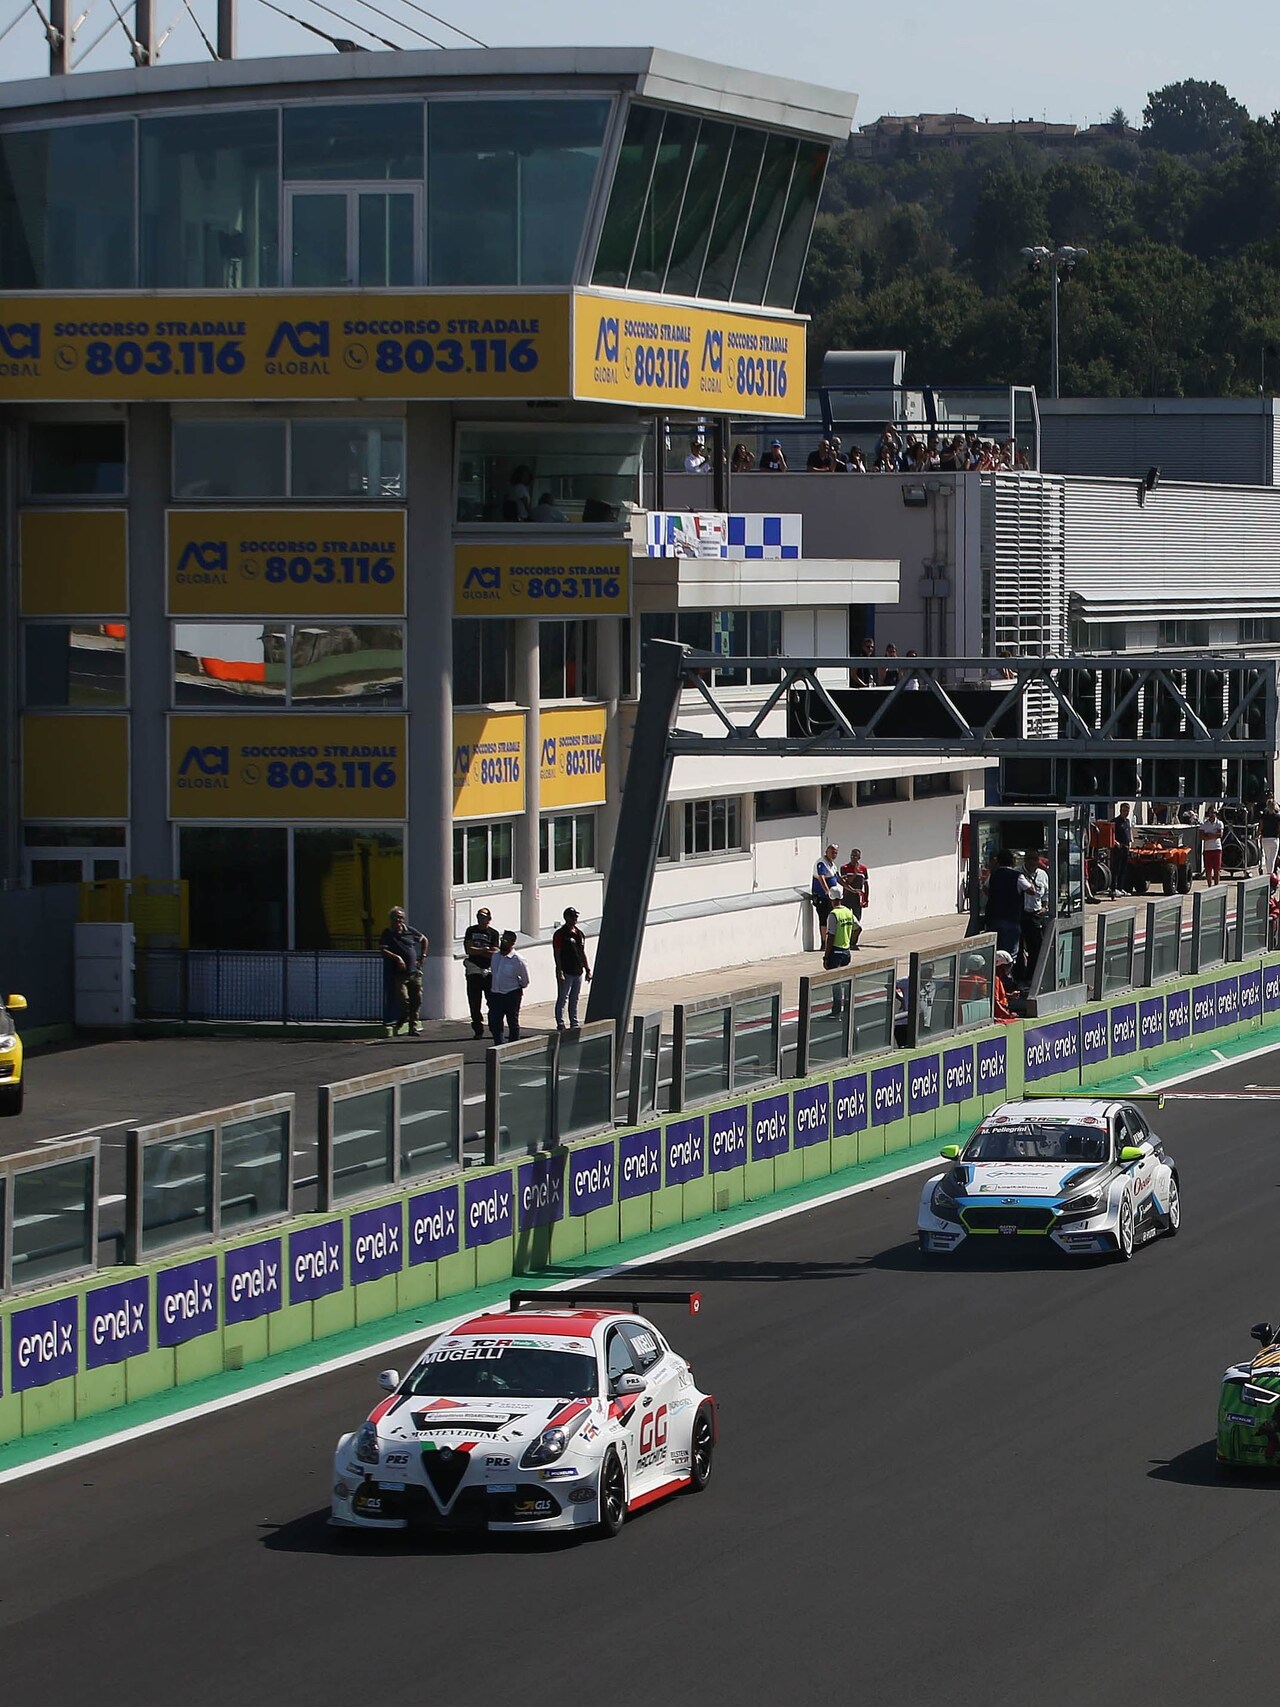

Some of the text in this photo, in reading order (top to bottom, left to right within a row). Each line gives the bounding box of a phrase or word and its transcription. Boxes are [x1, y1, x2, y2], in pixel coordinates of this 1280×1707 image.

[53, 321, 246, 336] SOCCORSO STRADALE
[343, 319, 540, 335] SOCCORSO STRADALE
[624, 319, 691, 343] SOCCORSO STRADALE
[727, 332, 788, 354] SOCCORSO STRADALE
[85, 340, 246, 376] 803.116
[376, 338, 539, 374] 803.116
[265, 361, 330, 375] GLOBAL
[593, 366, 619, 385] GLOBAL
[634, 345, 690, 390] 803.116
[736, 353, 788, 398] 803.116
[699, 375, 723, 394] GLOBAL
[239, 541, 396, 554] SOCCORSO STRADALE
[175, 574, 229, 585] GLOBAL
[265, 556, 395, 585] 803.116
[508, 566, 621, 576] SOCCORSO STRADALE
[462, 591, 502, 600] GLOBAL
[527, 577, 620, 600] 803.116
[240, 746, 397, 759] SOCCORSO STRADALE
[481, 757, 520, 786] 803.116
[566, 749, 602, 777] 803.116
[177, 778, 230, 789] GLOBAL
[266, 761, 396, 790] 803.116
[471, 1339, 514, 1348] TCR
[421, 1347, 505, 1365] MUGELLI
[385, 1455, 409, 1465] PRS
[485, 1456, 511, 1467] PRS
[535, 1500, 551, 1510] GLS
